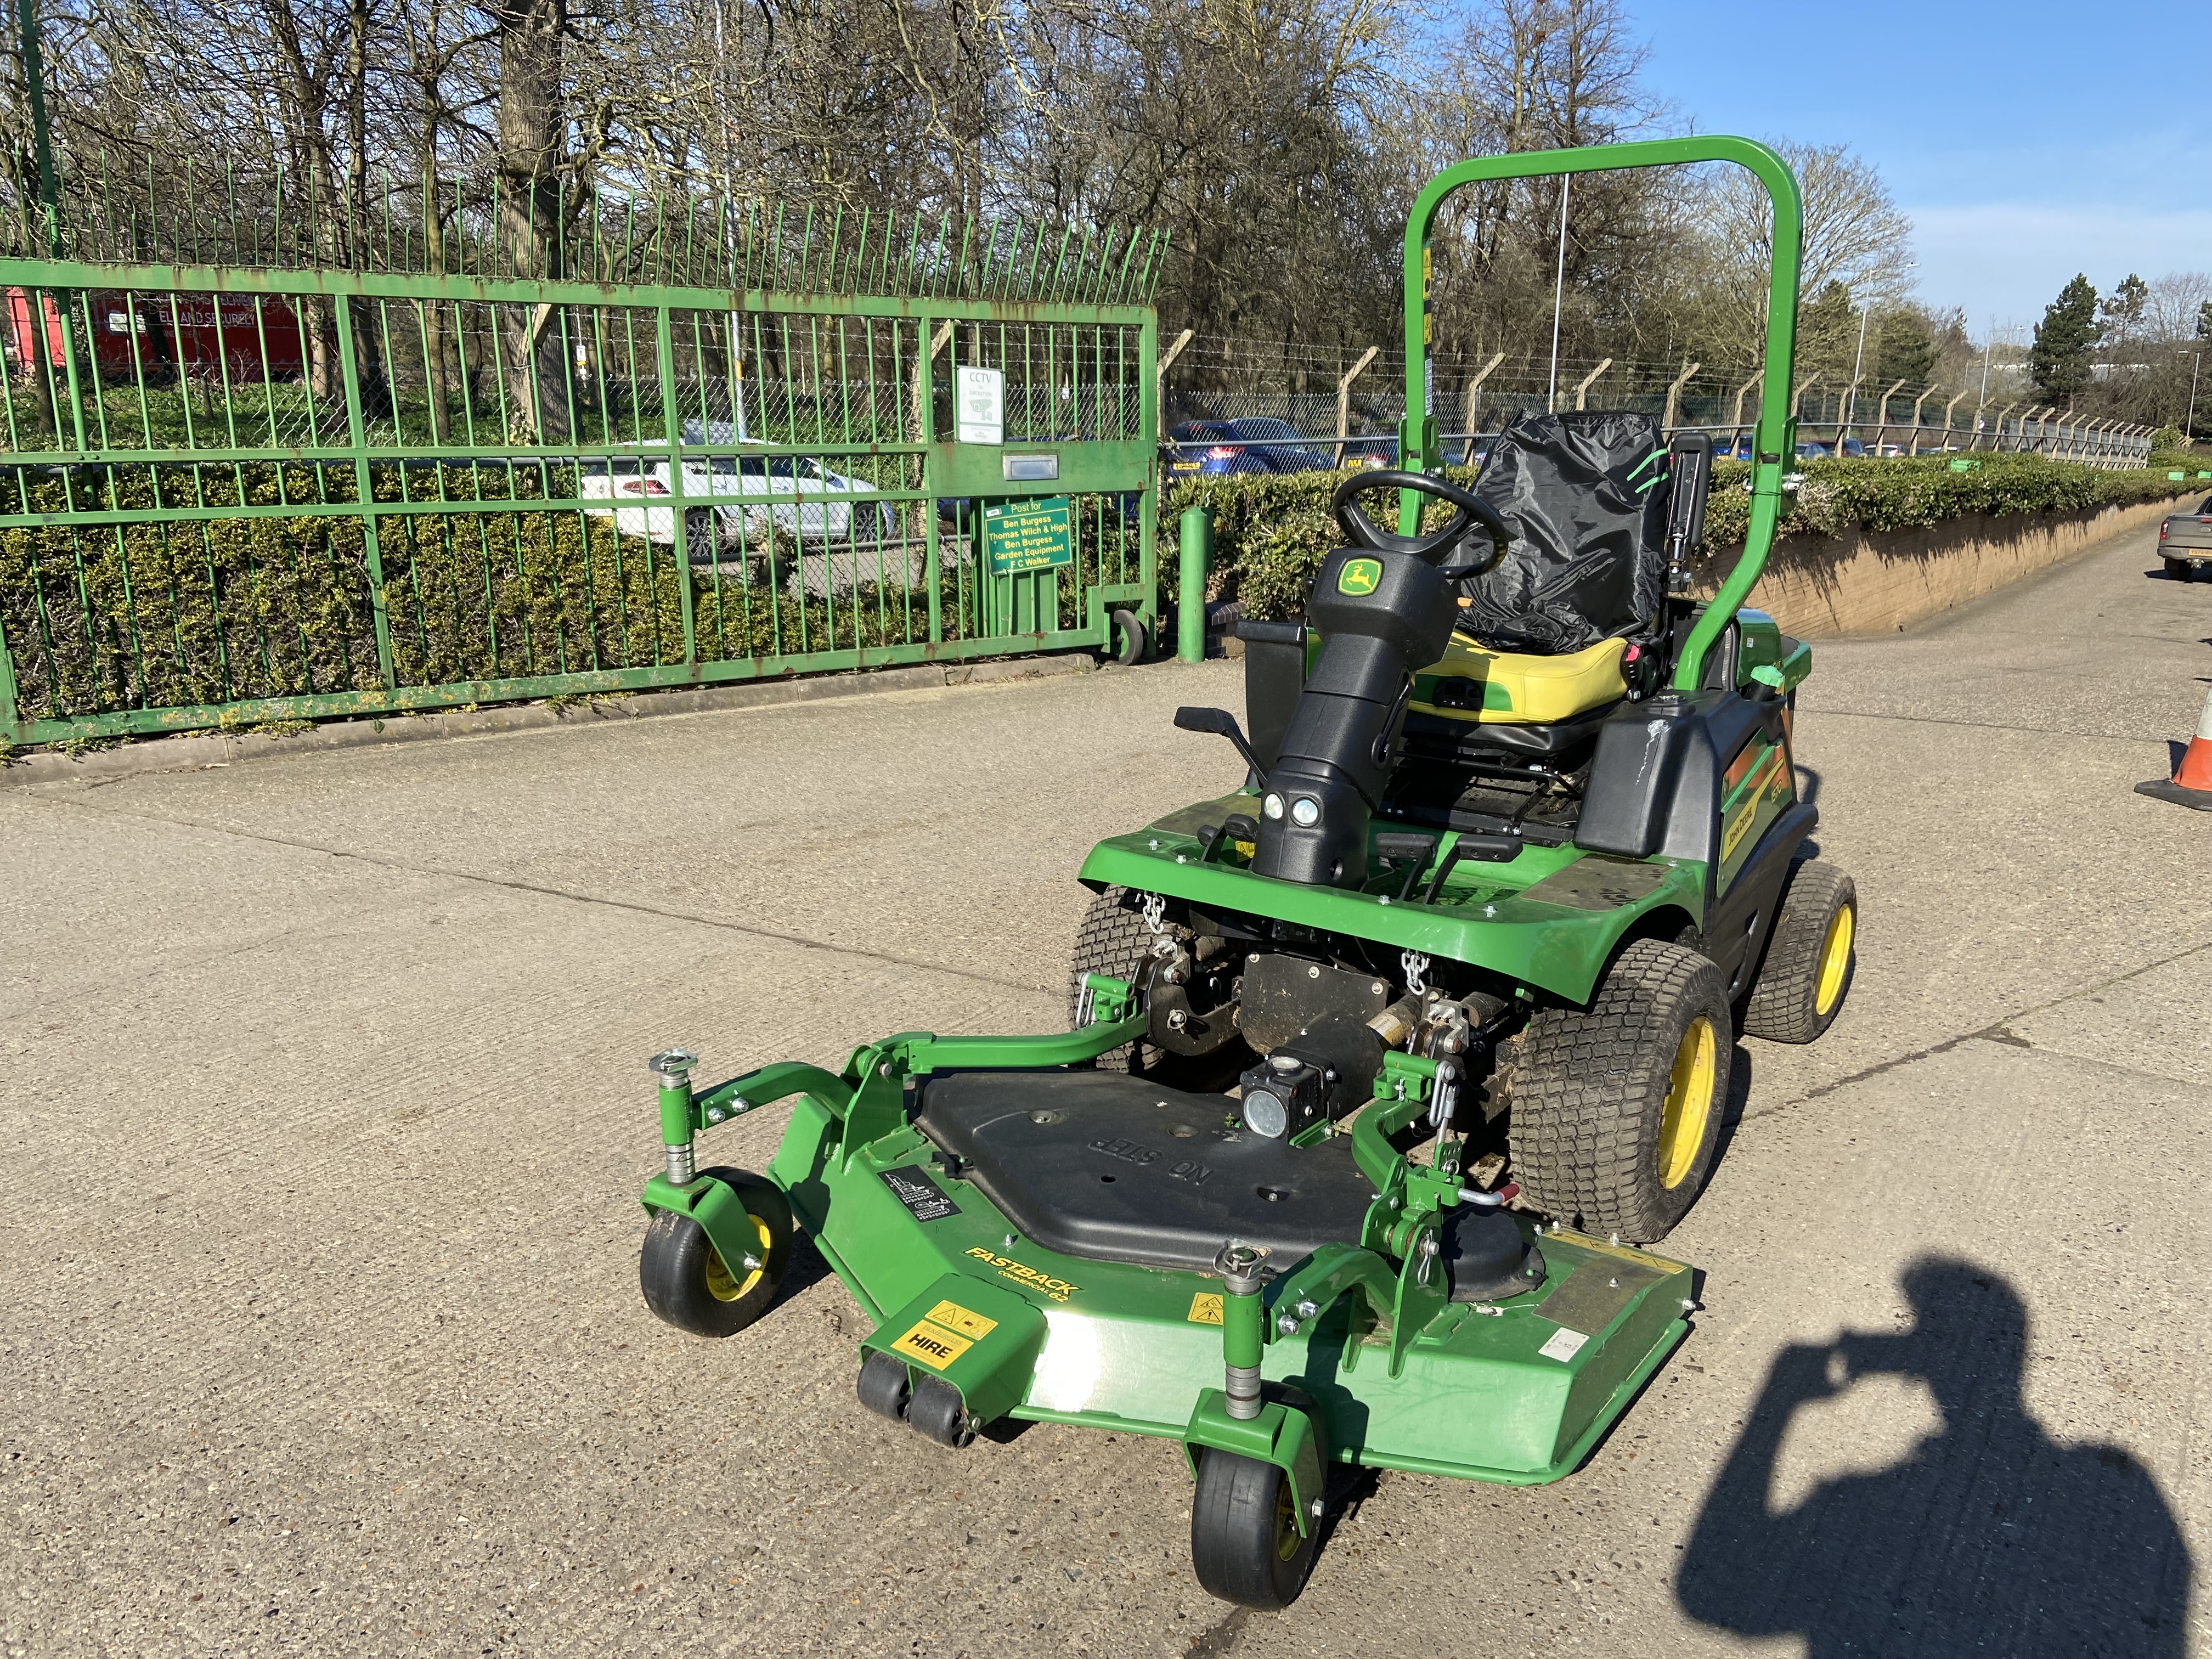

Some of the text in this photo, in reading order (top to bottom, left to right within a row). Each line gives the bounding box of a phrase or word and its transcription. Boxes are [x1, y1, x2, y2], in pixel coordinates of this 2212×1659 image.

[970, 373, 991, 383] CCTV
[1011, 502, 1041, 513] Post for
[1003, 516, 1051, 528] Ben Burgess
[989, 523, 1068, 541] Thomas Wilch & High
[1005, 536, 1053, 549] Ben Burgess
[995, 544, 1064, 561] Garden Equipment
[1011, 561, 1015, 569] F
[1025, 557, 1050, 567] Walker
[1729, 806, 1752, 847] JOHN DEERE
[1088, 1138, 1214, 1186] NO STEP
[964, 1247, 1080, 1295] FASTBACK
[997, 1271, 1069, 1302] COMMERCIAL 62
[907, 1333, 953, 1359] HIRE
